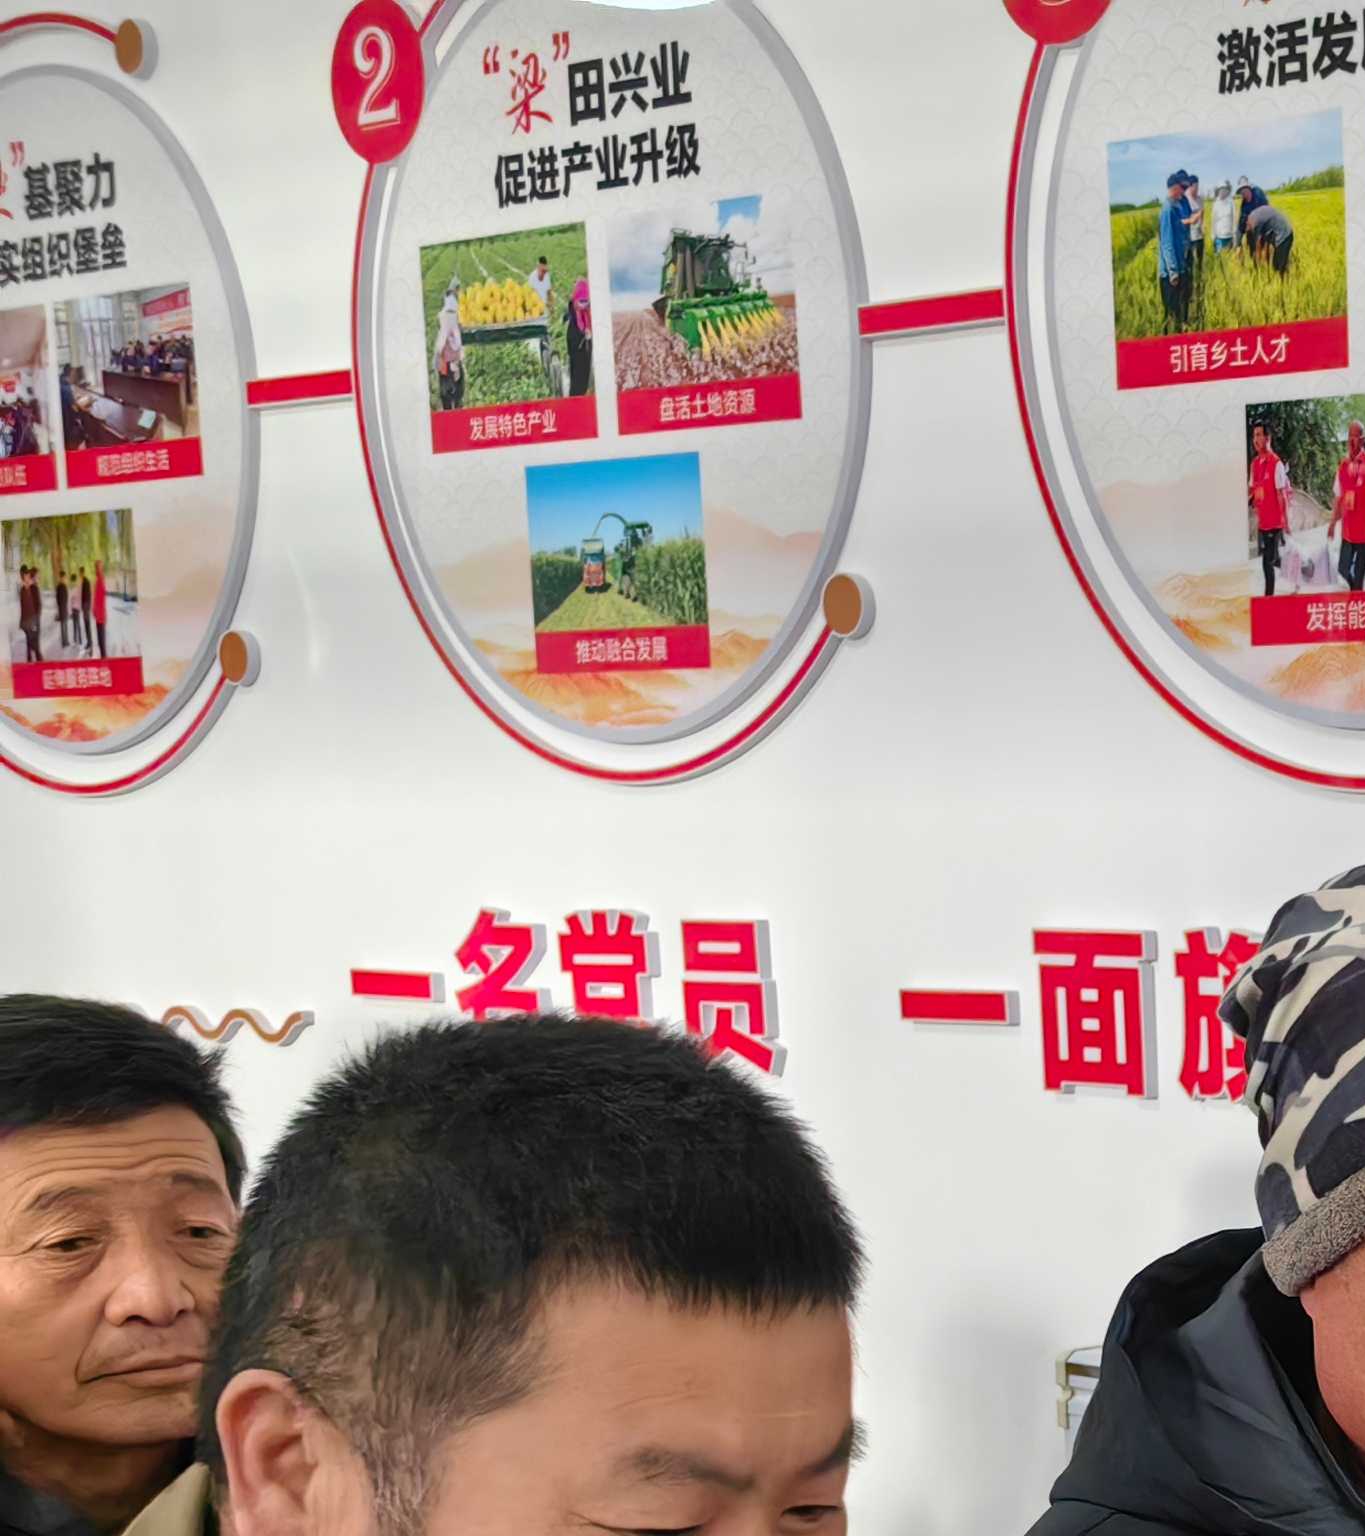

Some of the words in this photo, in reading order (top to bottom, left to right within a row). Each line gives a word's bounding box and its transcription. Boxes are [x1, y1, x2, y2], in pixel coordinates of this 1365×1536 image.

[353, 26, 400, 131] 2
[495, 124, 700, 208] 促进产业升级
[1169, 334, 1291, 372] 引育乡土人才
[659, 388, 756, 421] 盘活土地资源
[470, 410, 556, 441] 发展特色产业
[576, 636, 667, 664] 推动融合发展
